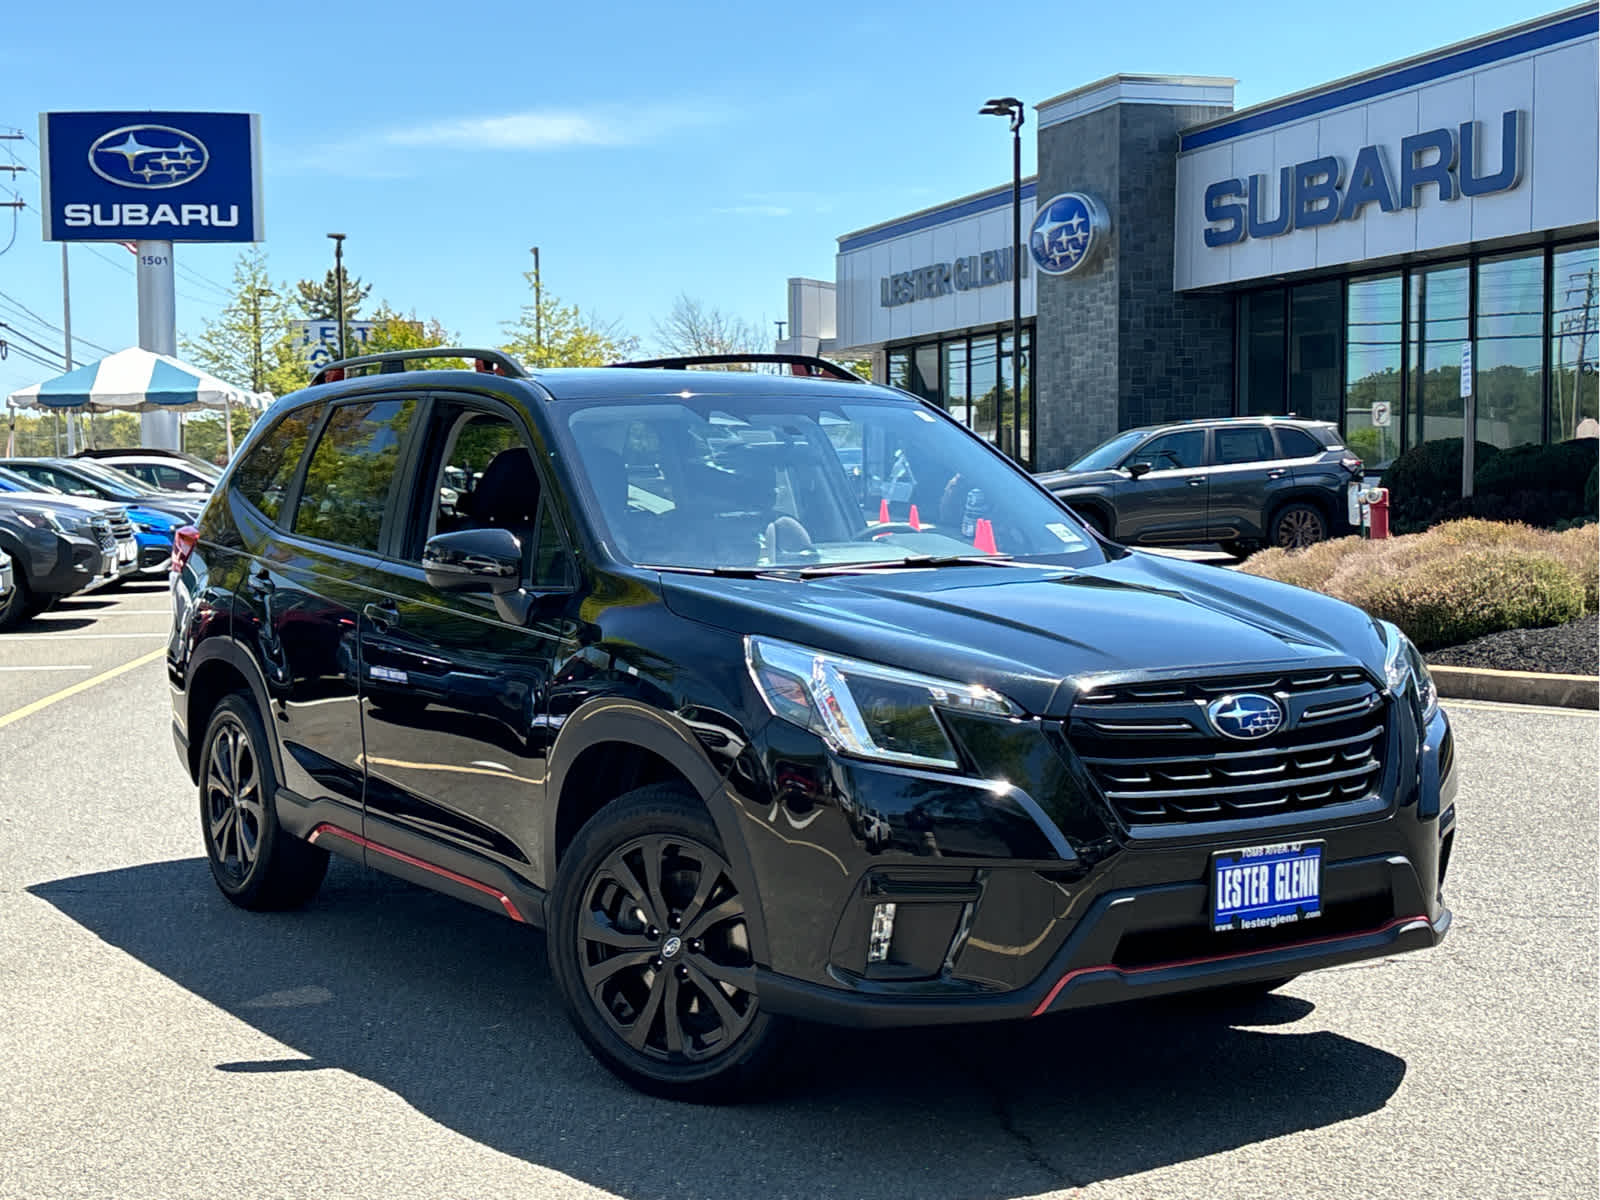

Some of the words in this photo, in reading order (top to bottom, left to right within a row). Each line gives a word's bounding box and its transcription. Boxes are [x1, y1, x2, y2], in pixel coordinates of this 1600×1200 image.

[1203, 109, 1525, 248] SUBARU
[64, 203, 239, 227] SUBARU
[142, 255, 168, 265] 1501
[880, 263, 953, 308] LESTER
[1217, 864, 1269, 910] LESTER
[1275, 858, 1320, 902] GLENN
[1241, 912, 1298, 929] lesterglenn
